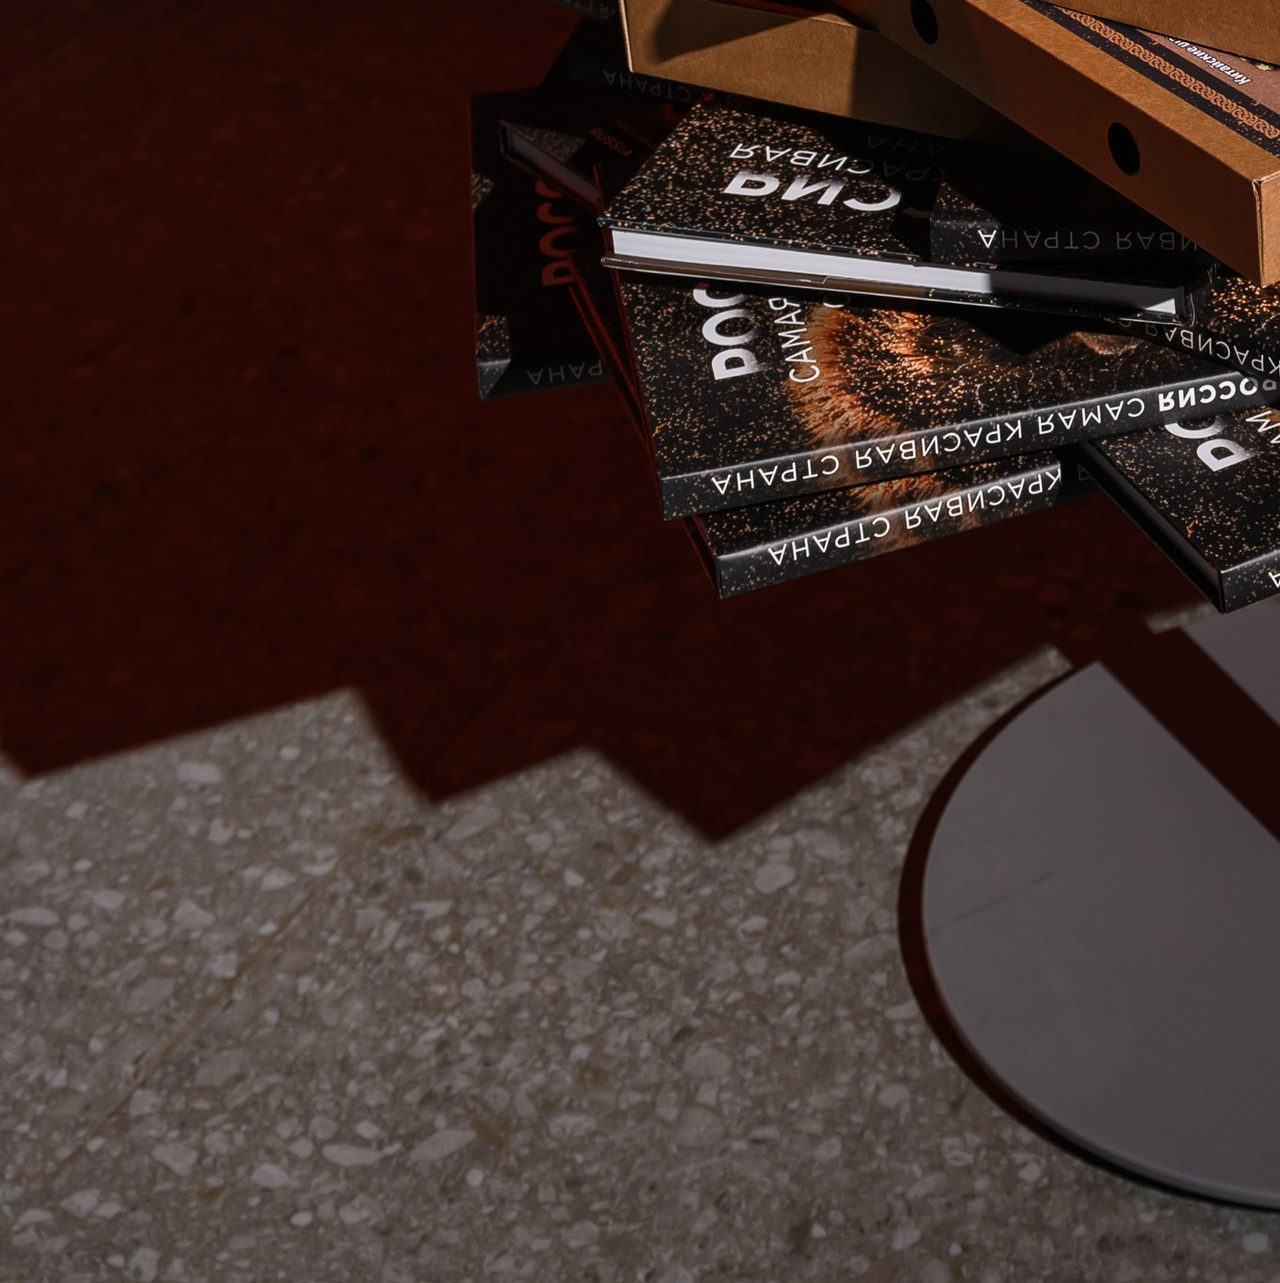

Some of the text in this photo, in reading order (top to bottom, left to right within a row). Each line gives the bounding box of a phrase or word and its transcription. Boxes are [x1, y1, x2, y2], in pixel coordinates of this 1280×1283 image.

[602, 68, 692, 104] СТРАНА
[978, 230, 1099, 250] СТРАНА
[711, 373, 1278, 495] РОССИЯ САМАЯ КРАСИВАЯ СТРАНА
[768, 472, 1063, 566] КРАСИВАЯ СТРАНА
